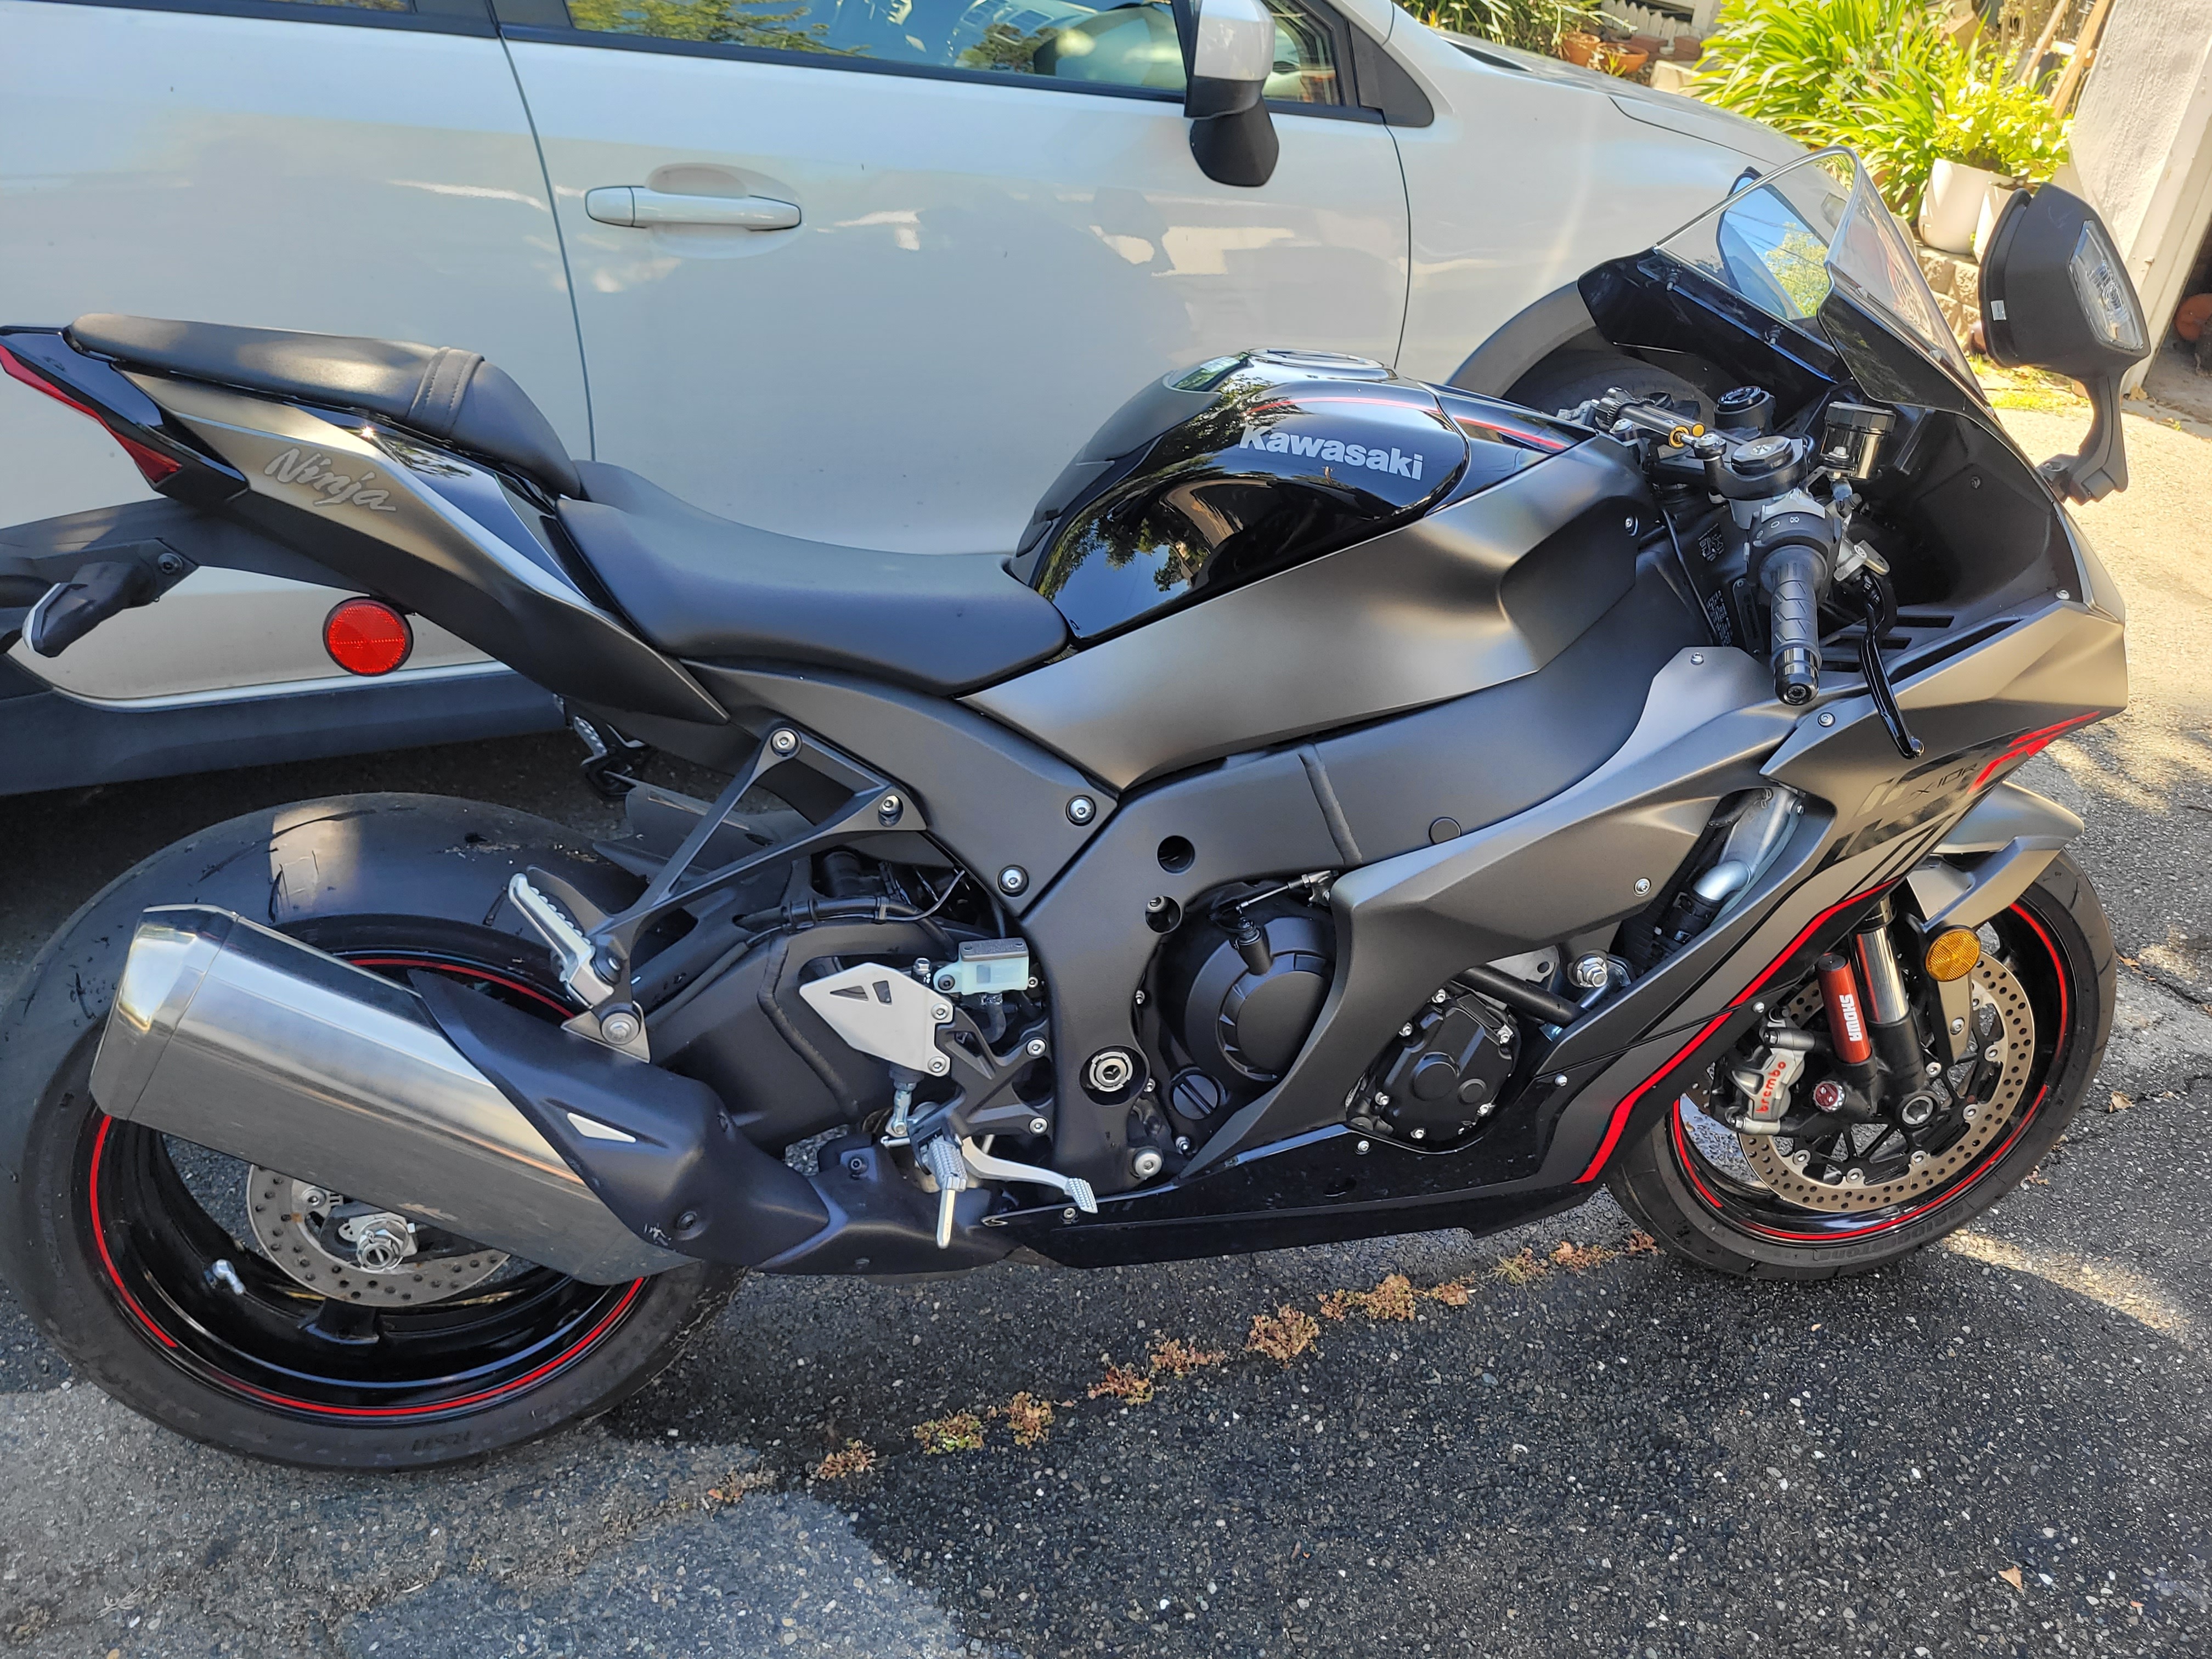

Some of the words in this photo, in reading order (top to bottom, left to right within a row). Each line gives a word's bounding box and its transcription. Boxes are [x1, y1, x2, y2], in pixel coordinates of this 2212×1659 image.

[264, 447, 397, 512] Ninja
[1239, 424, 1423, 481] Kawasaki
[1839, 994, 1863, 1041] SHOWA
[1756, 1062, 1786, 1113] brembo
